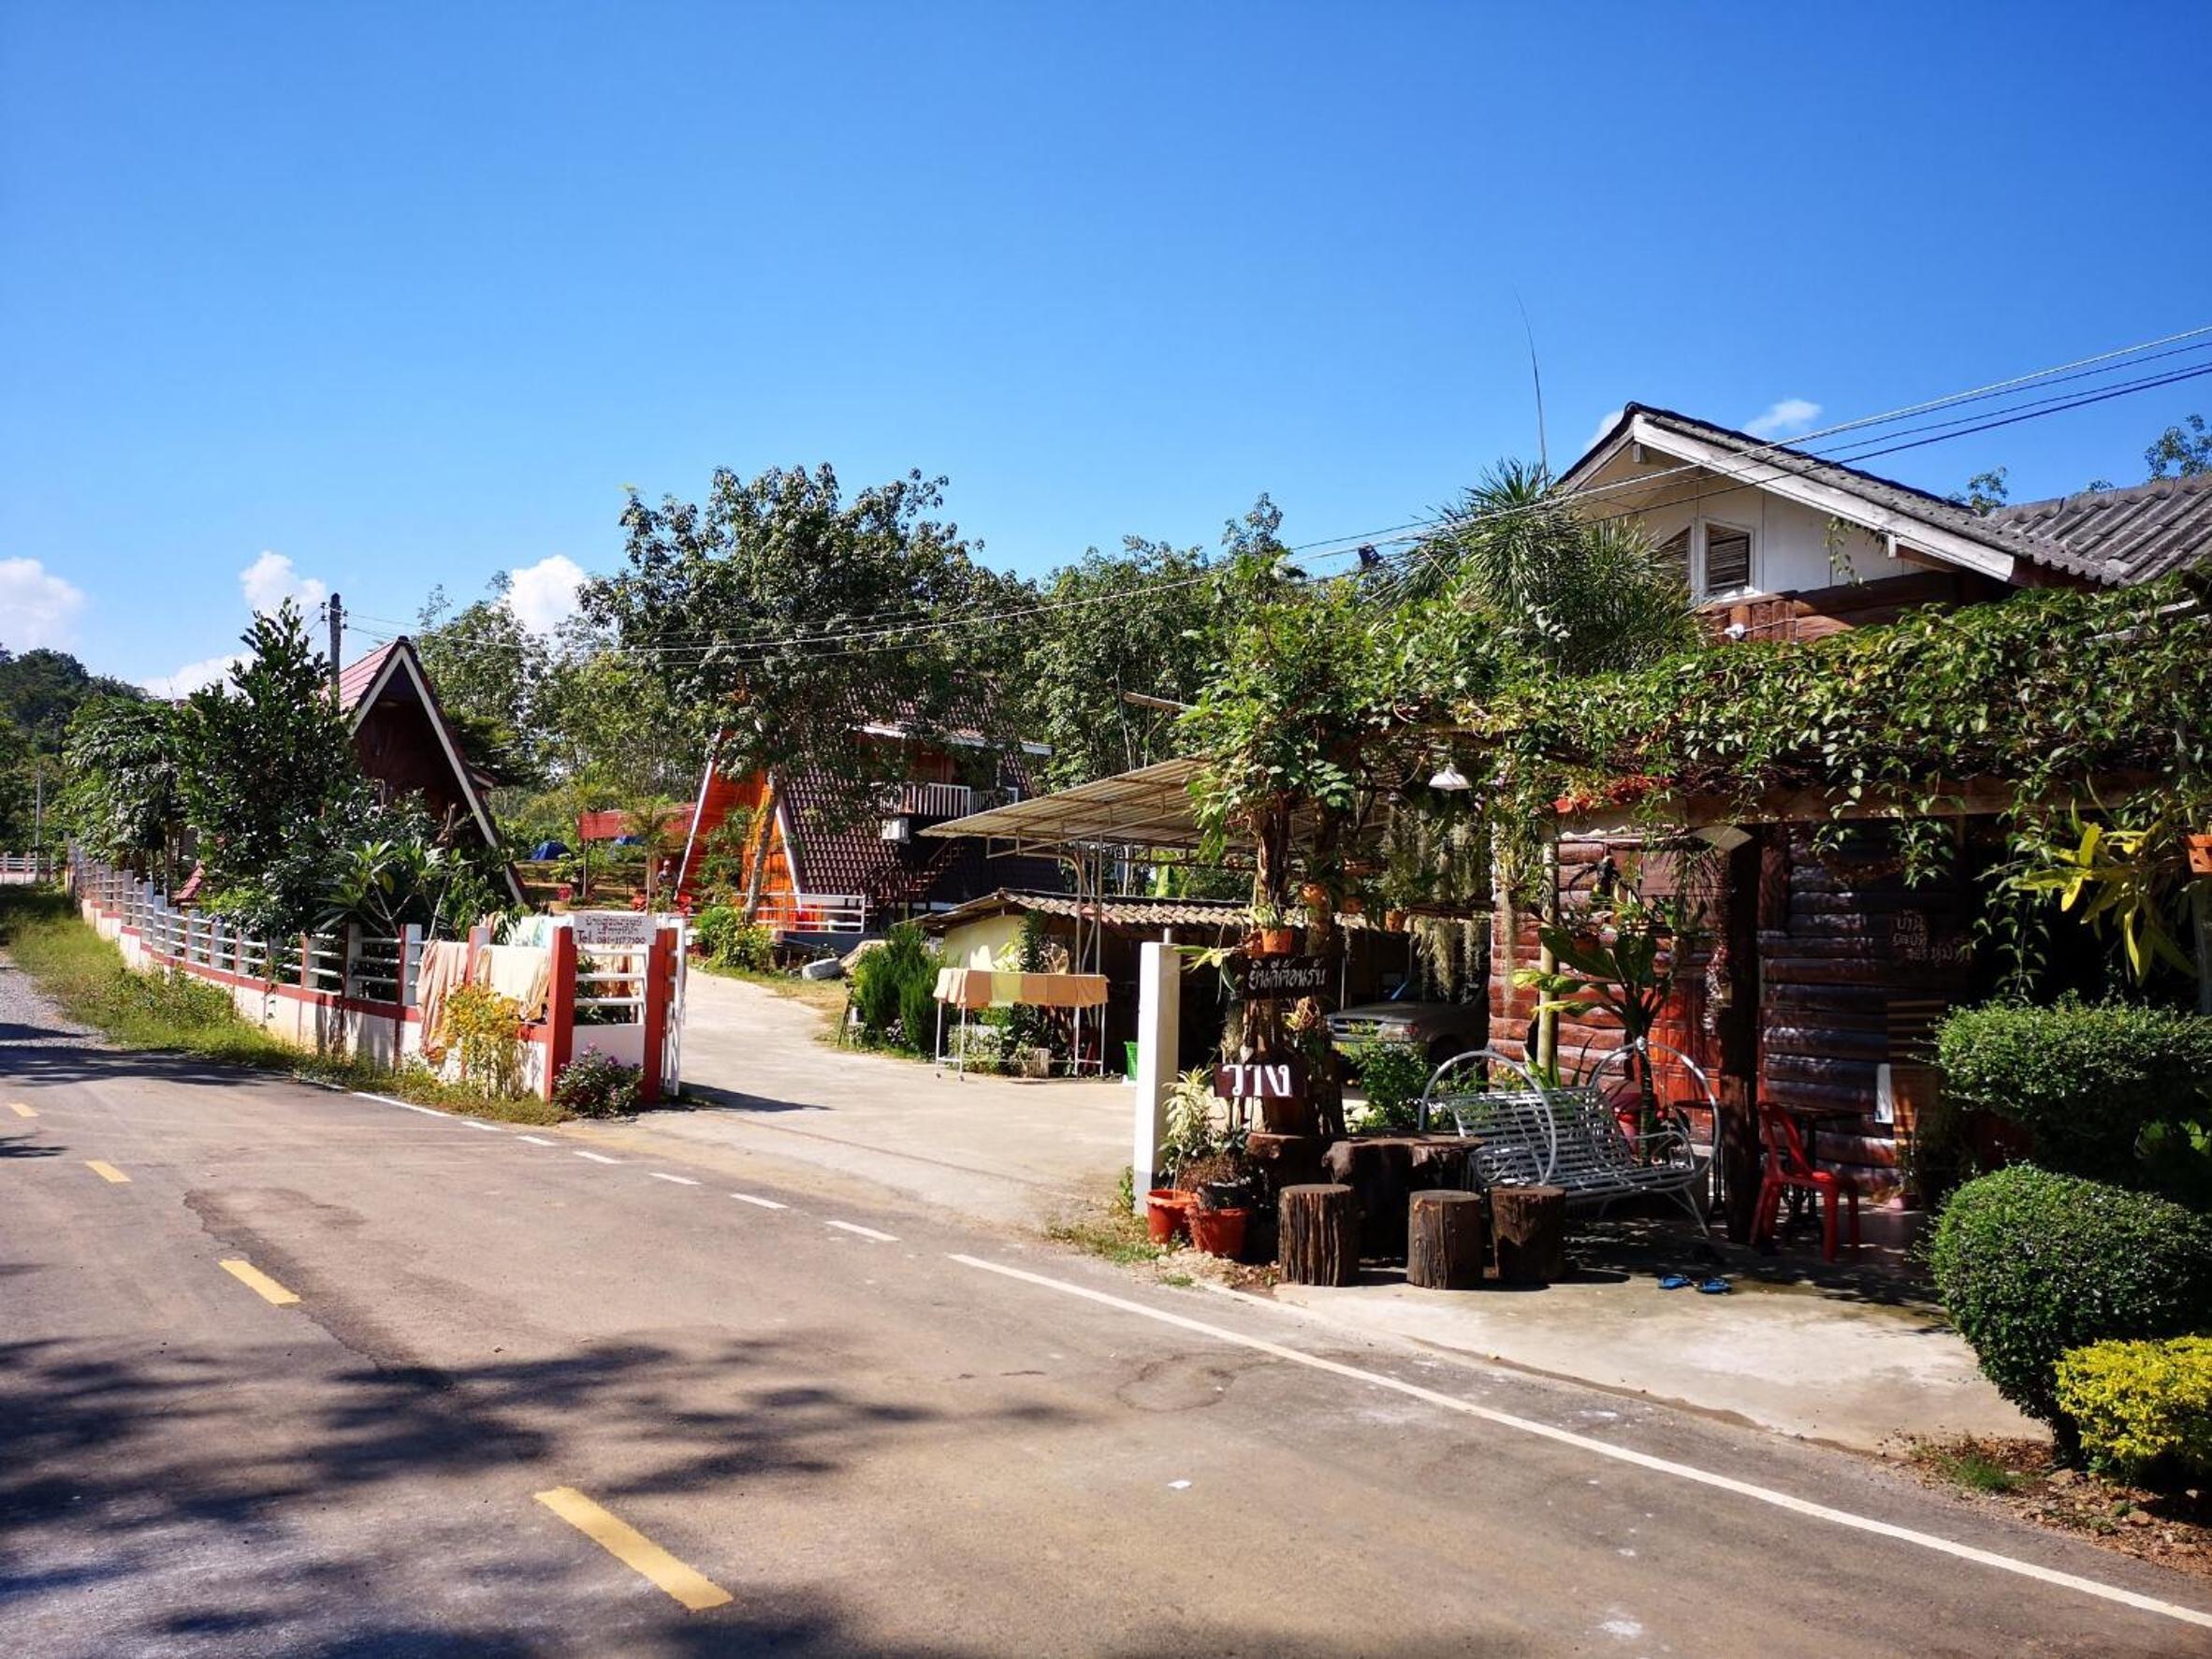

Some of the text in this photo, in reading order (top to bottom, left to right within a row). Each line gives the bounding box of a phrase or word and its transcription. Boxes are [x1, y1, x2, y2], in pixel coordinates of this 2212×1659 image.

[576, 929, 595, 945] Tel.
[1248, 957, 1327, 991] ยินดีต้อนรับ
